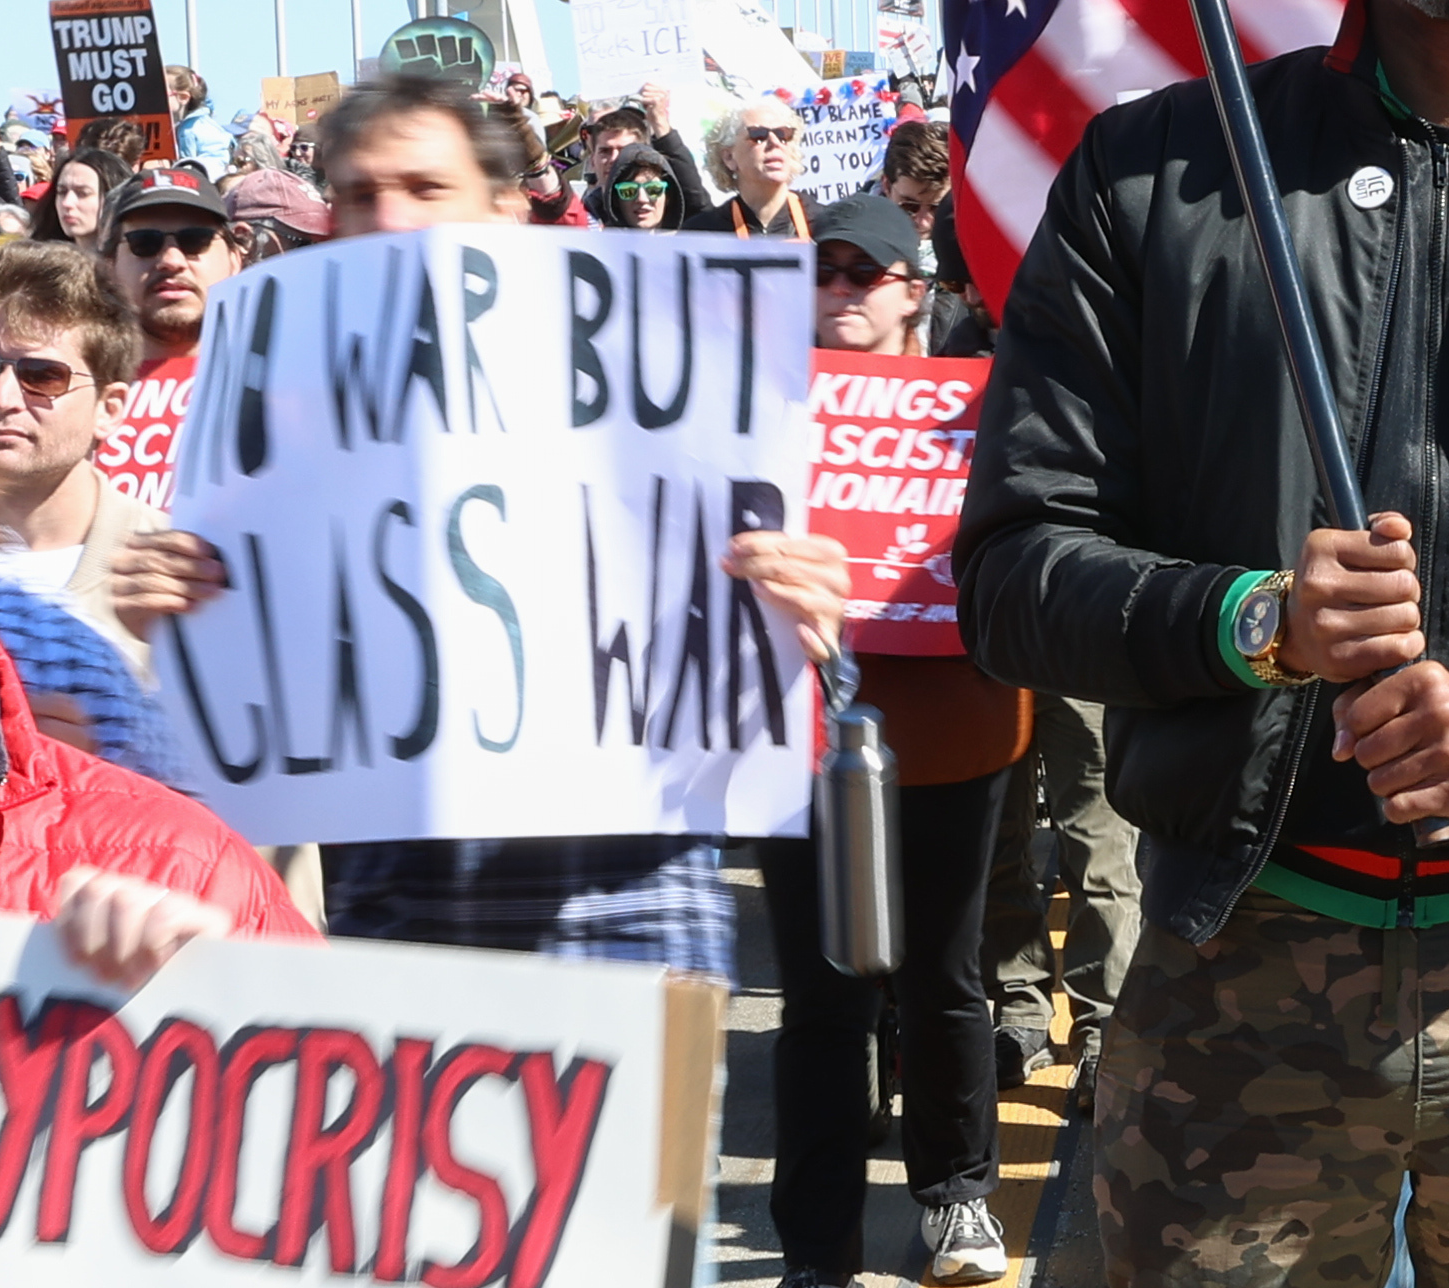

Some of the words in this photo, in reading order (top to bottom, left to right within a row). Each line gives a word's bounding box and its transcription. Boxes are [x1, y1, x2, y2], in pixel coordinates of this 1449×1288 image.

[54, 16, 152, 49] TRUMP
[67, 48, 148, 82] MUST
[92, 81, 136, 113] GO
[828, 102, 883, 122] BLAME
[834, 151, 873, 171] YOU
[1367, 175, 1386, 198] ICE
[324, 243, 508, 453] WAR
[566, 245, 802, 435] BUT
[808, 372, 973, 422] KINGS
[805, 421, 976, 471] SCIST
[168, 482, 525, 784] CLASS
[578, 473, 793, 752] WAR
